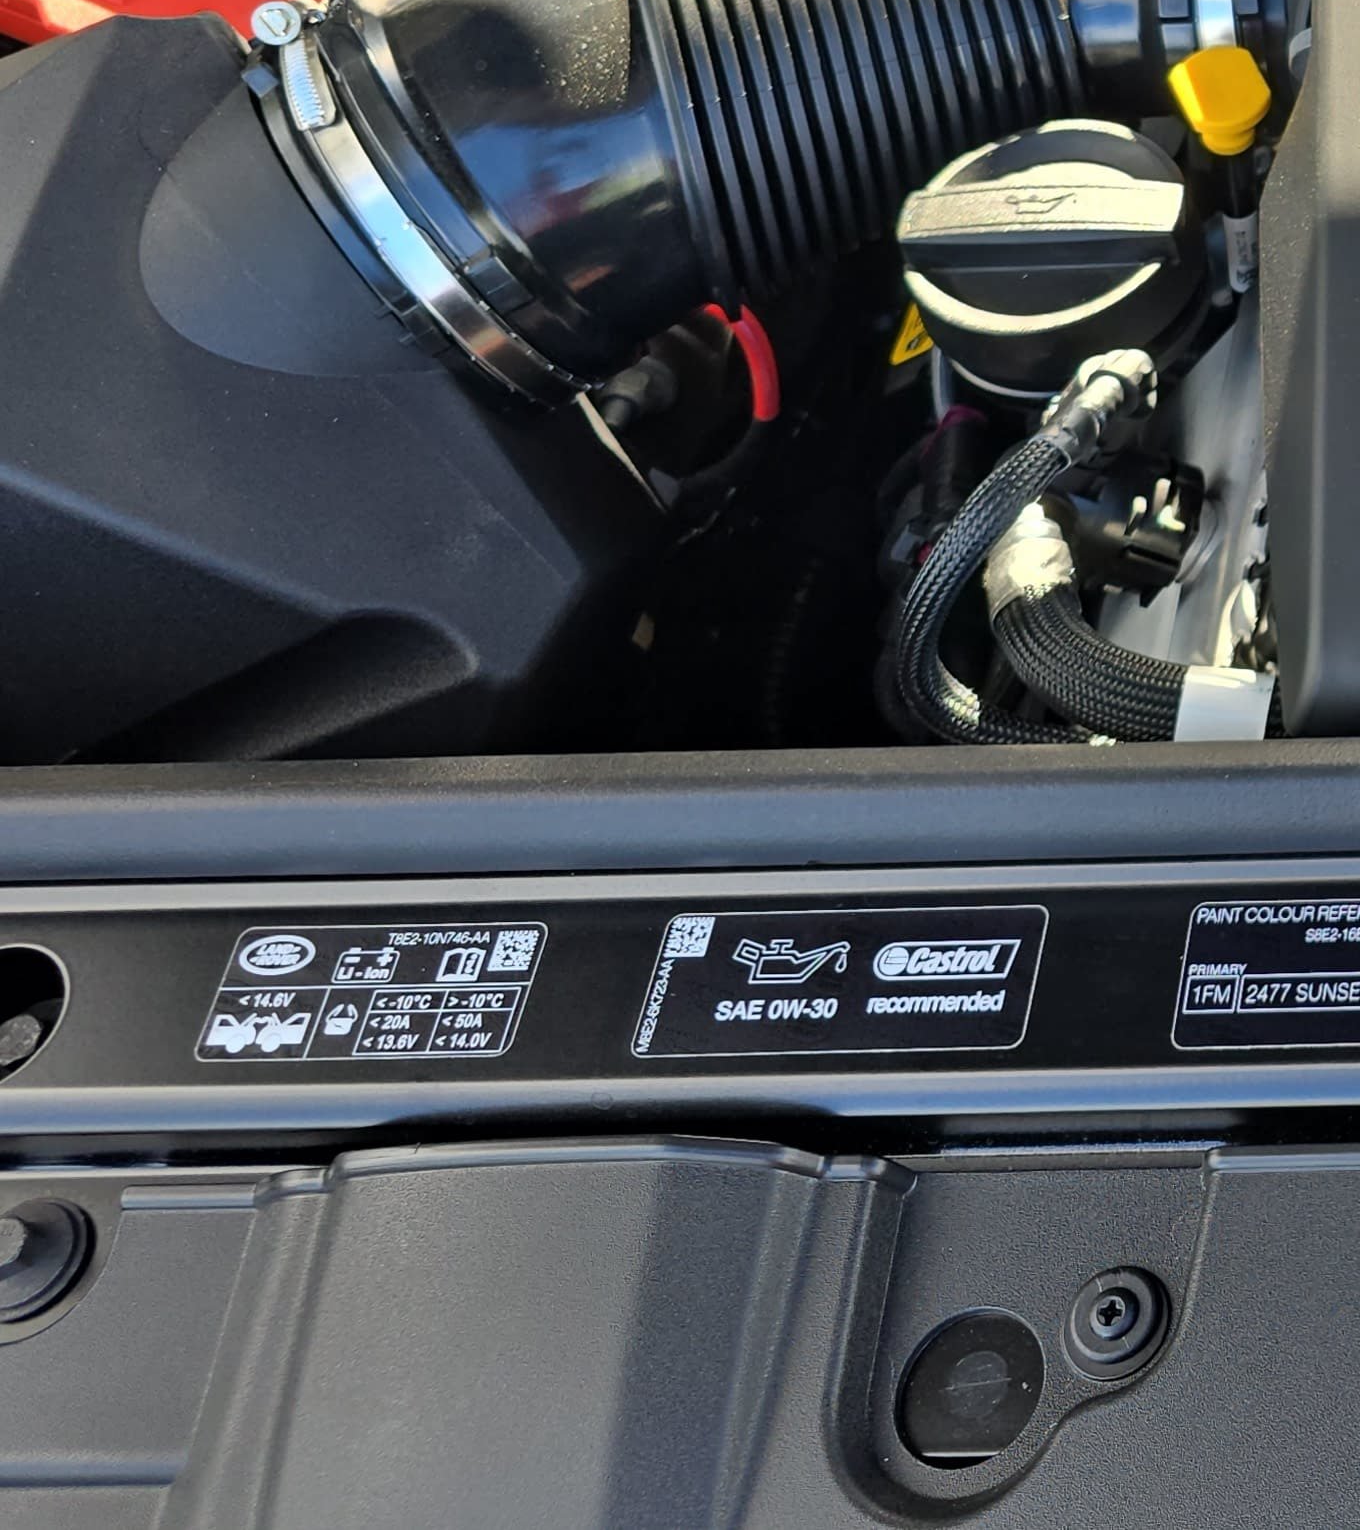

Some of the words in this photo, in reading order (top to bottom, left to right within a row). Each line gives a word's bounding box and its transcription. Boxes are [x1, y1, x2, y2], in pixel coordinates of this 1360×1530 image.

[1196, 906, 1243, 924] PAINT
[1245, 905, 1315, 923] COLOUR
[906, 945, 998, 975] Castrol
[1188, 963, 1247, 976] PRIMARY
[253, 992, 296, 1008] 14.6V
[866, 989, 1005, 1014] recommended
[1192, 984, 1231, 1005] 1FM
[1244, 983, 1291, 1004] 2477
[714, 999, 765, 1021] SAE
[767, 998, 838, 1020] 0W-30
[381, 1015, 410, 1030] 20A
[454, 1013, 482, 1028] 50A
[377, 1034, 420, 1050] 13.6V
[450, 1032, 492, 1048] 14.0V
